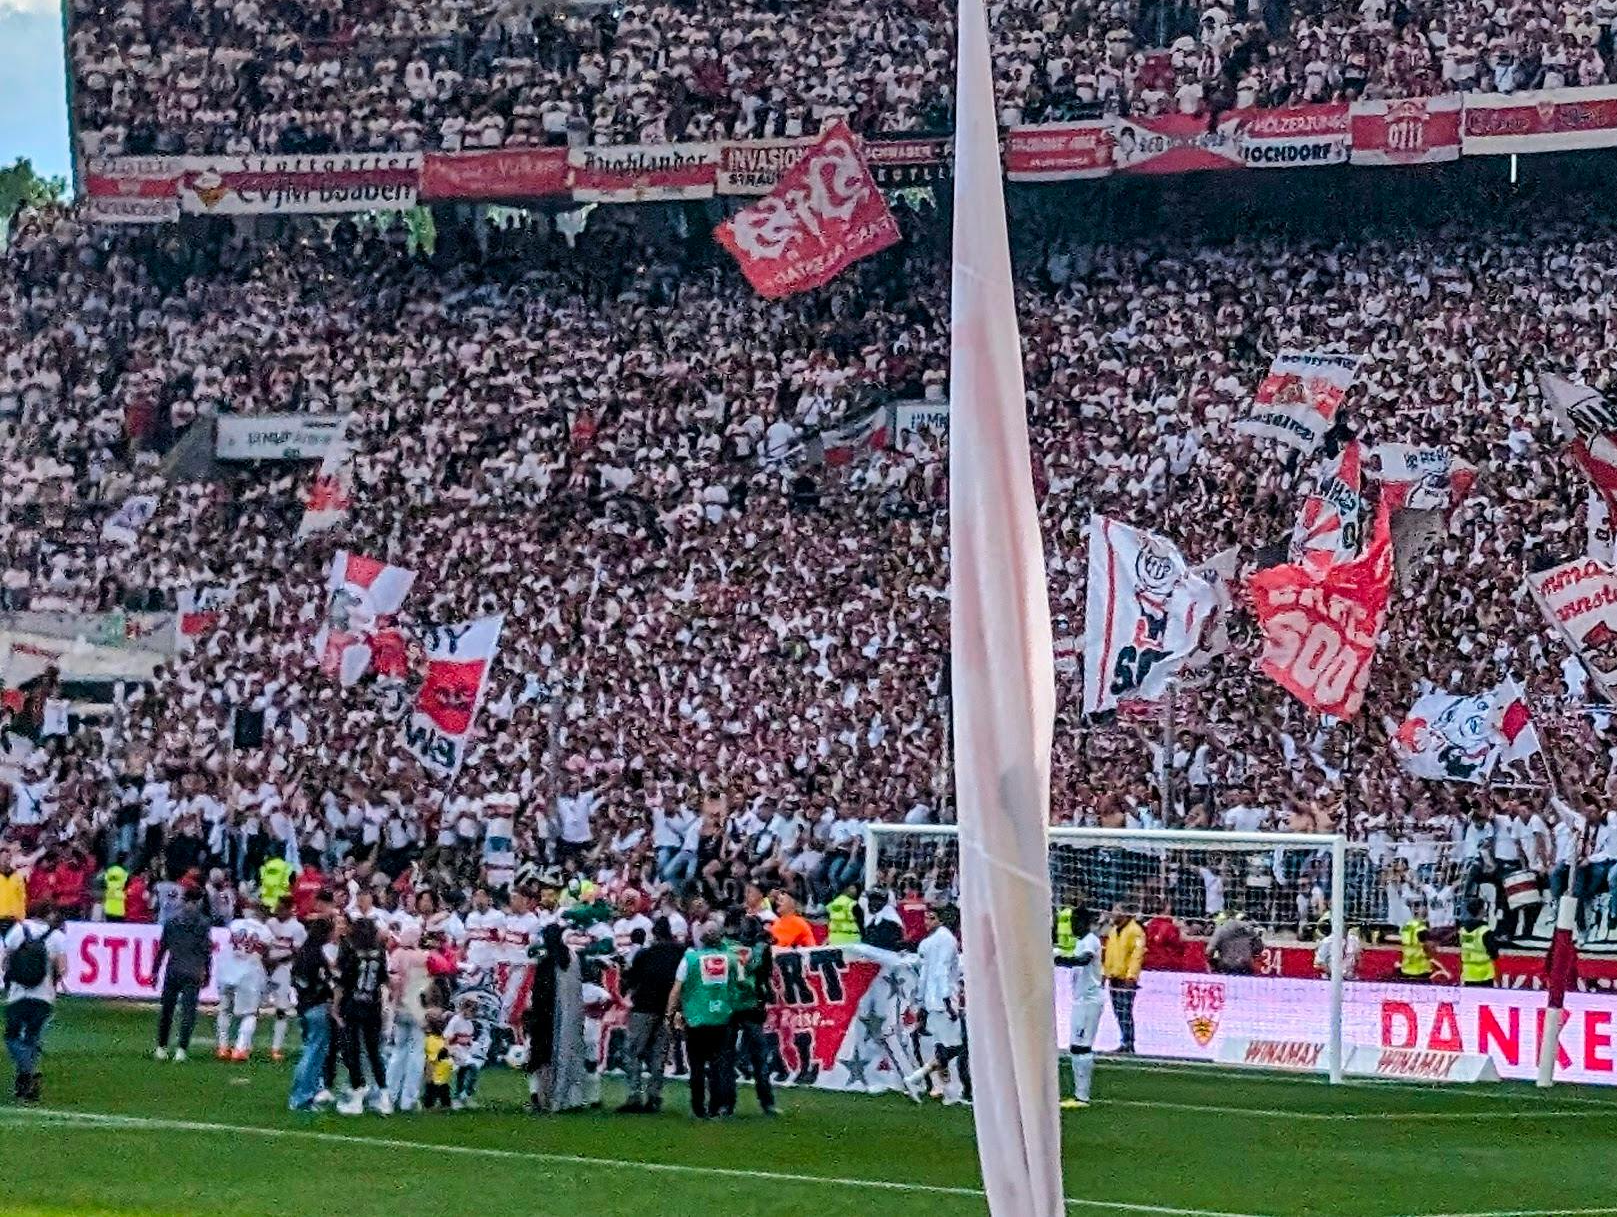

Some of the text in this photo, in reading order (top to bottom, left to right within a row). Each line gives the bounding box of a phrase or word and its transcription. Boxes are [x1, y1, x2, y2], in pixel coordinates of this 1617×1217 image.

[1381, 1000, 1614, 1071] DANKE
[1245, 1039, 1325, 1067] WINAMAX
[1376, 1048, 1459, 1078] WINAMAX
